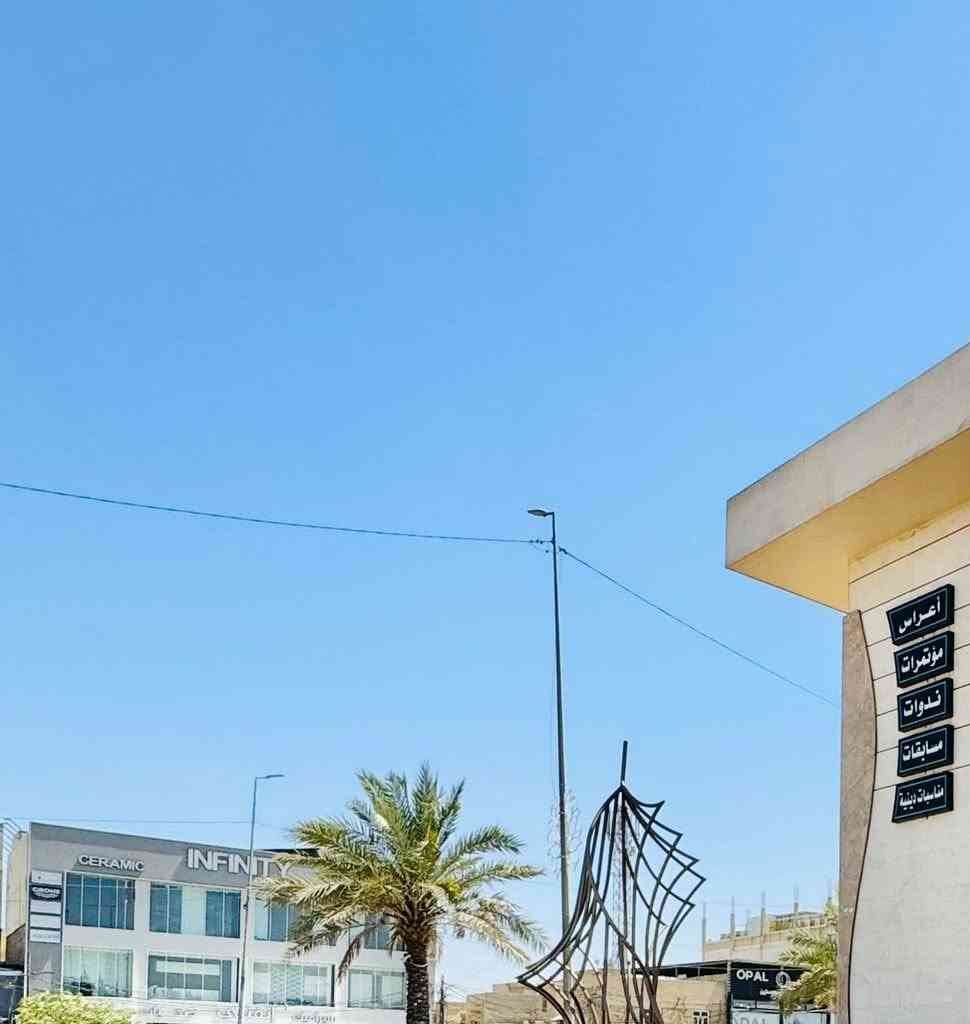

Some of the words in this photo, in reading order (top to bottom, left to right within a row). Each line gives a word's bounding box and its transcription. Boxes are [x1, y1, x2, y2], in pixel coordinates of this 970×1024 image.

[898, 595, 941, 634] أعراس
[901, 646, 944, 674] مؤتمرات
[903, 690, 942, 717] ندوات
[902, 740, 944, 762] مسابقات
[78, 854, 145, 872] CERAMIC
[736, 969, 769, 982] OPAL
